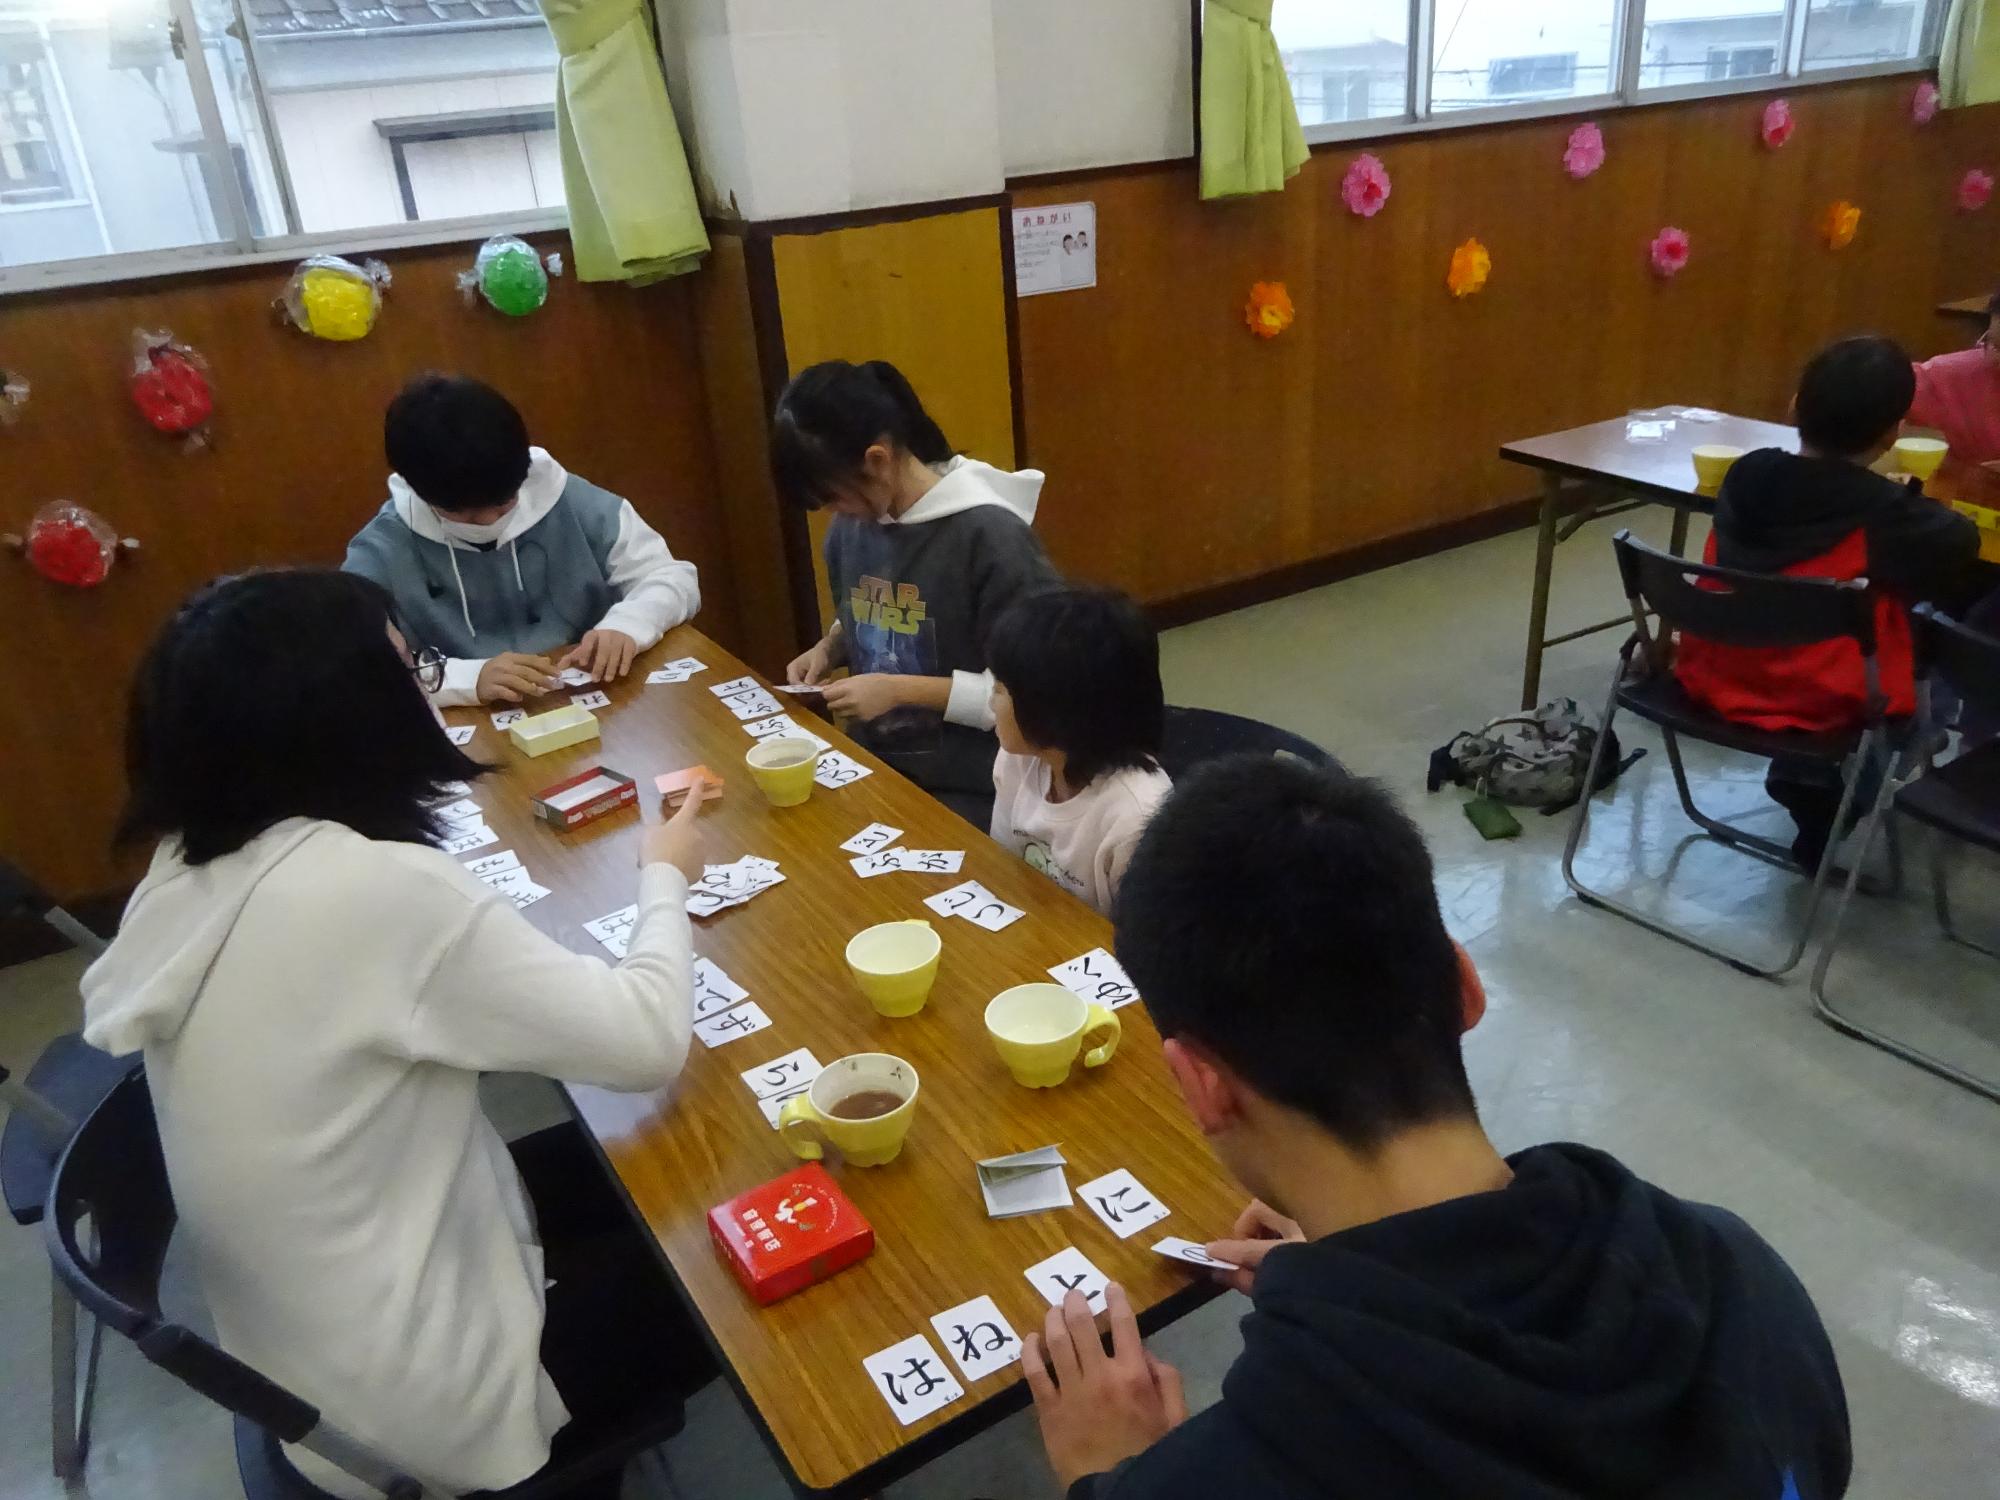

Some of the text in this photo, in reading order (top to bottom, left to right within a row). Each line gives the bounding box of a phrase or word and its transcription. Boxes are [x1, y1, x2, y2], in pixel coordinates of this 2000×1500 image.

[917, 852, 949, 870] が
[1095, 981, 1135, 1005] ゆ
[708, 1012, 756, 1032] ず
[761, 1060, 800, 1087] ら
[1094, 1186, 1152, 1223] に
[951, 1321, 1014, 1362] ね
[881, 1357, 946, 1405] は
